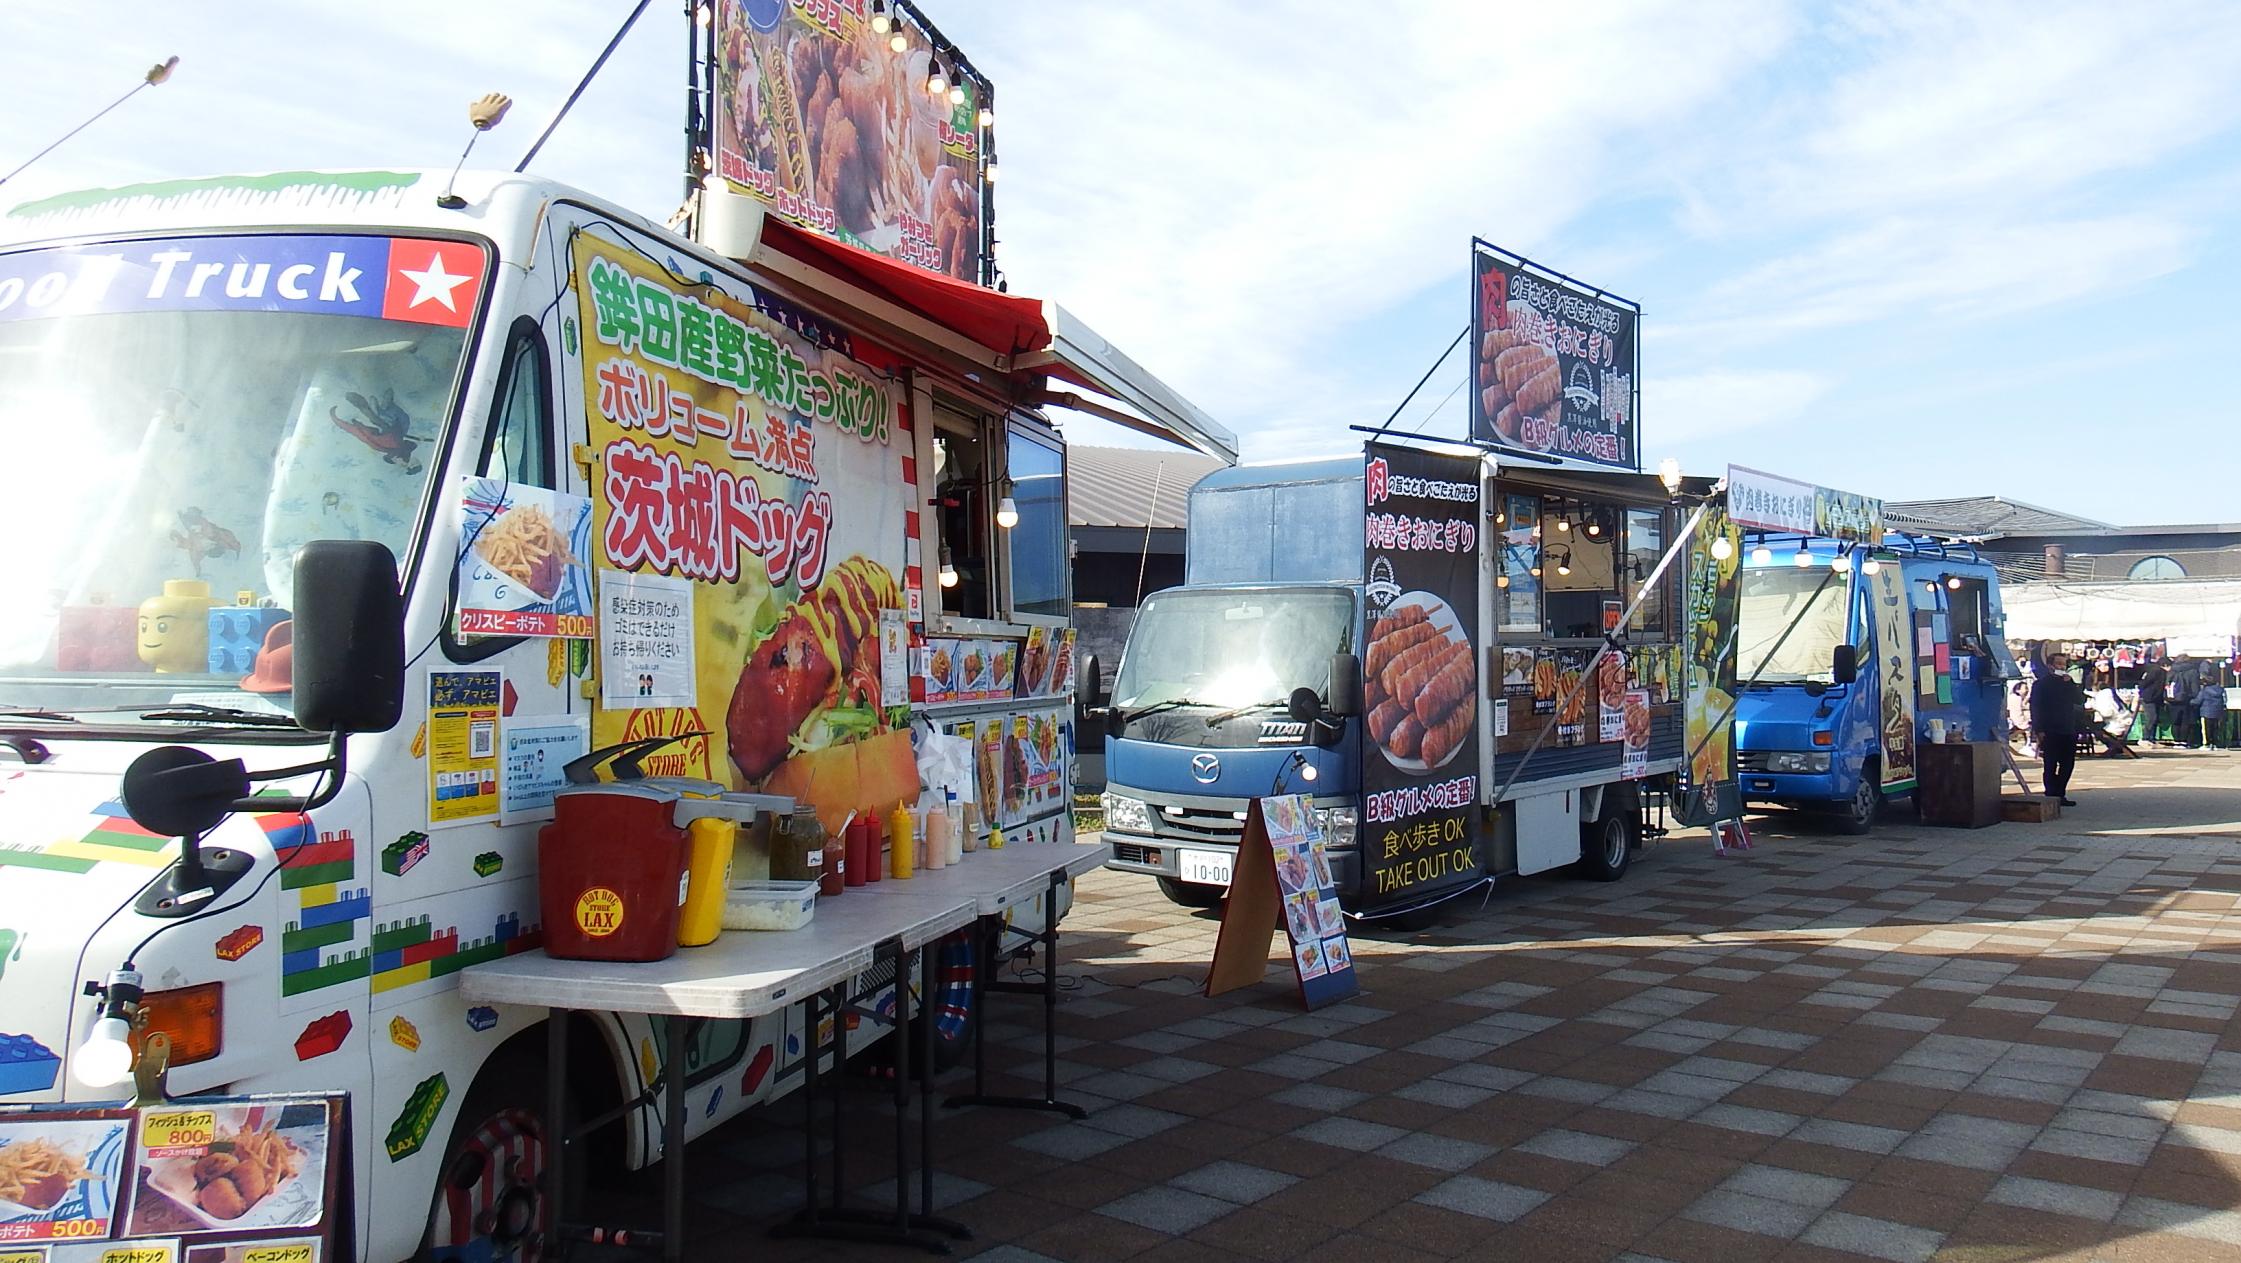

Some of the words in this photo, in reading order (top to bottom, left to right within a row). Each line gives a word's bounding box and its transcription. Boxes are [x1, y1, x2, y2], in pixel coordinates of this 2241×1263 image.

[777, 186, 835, 232] ホットドッグ
[899, 211, 933, 244] やみつき
[900, 235, 942, 270] ガーリック
[146, 251, 363, 302] Truck
[589, 257, 889, 444] 鉾田産野菜たっぷり!
[1511, 306, 1614, 367] 肉巻きおにぎり
[598, 358, 819, 485] ボリューム満点
[604, 437, 832, 592] 茨城ドッグ
[1365, 512, 1475, 553] 肉巻きおにぎり
[461, 613, 545, 632] クリスピーポテト
[557, 615, 592, 636] 500円
[614, 617, 676, 639] ゴミはできるだけ
[612, 639, 680, 659] お持ち帰りください
[1260, 721, 1307, 735] TITAN
[1383, 820, 1441, 859] 食べ歩き
[1444, 816, 1466, 841] OK
[1375, 861, 1413, 894] TAKE
[1417, 852, 1449, 881] OUT
[1453, 846, 1475, 872] OK
[584, 912, 614, 928] LAX
[217, 948, 234, 958] LAX
[236, 932, 262, 956] STORE
[388, 1135, 416, 1156] LAX
[416, 1081, 446, 1138] STORE
[169, 1129, 212, 1144] 800円
[52, 1219, 105, 1237] 500円
[106, 1250, 166, 1263] ホットドッグ
[246, 1247, 311, 1260] ベーコンドッグ
